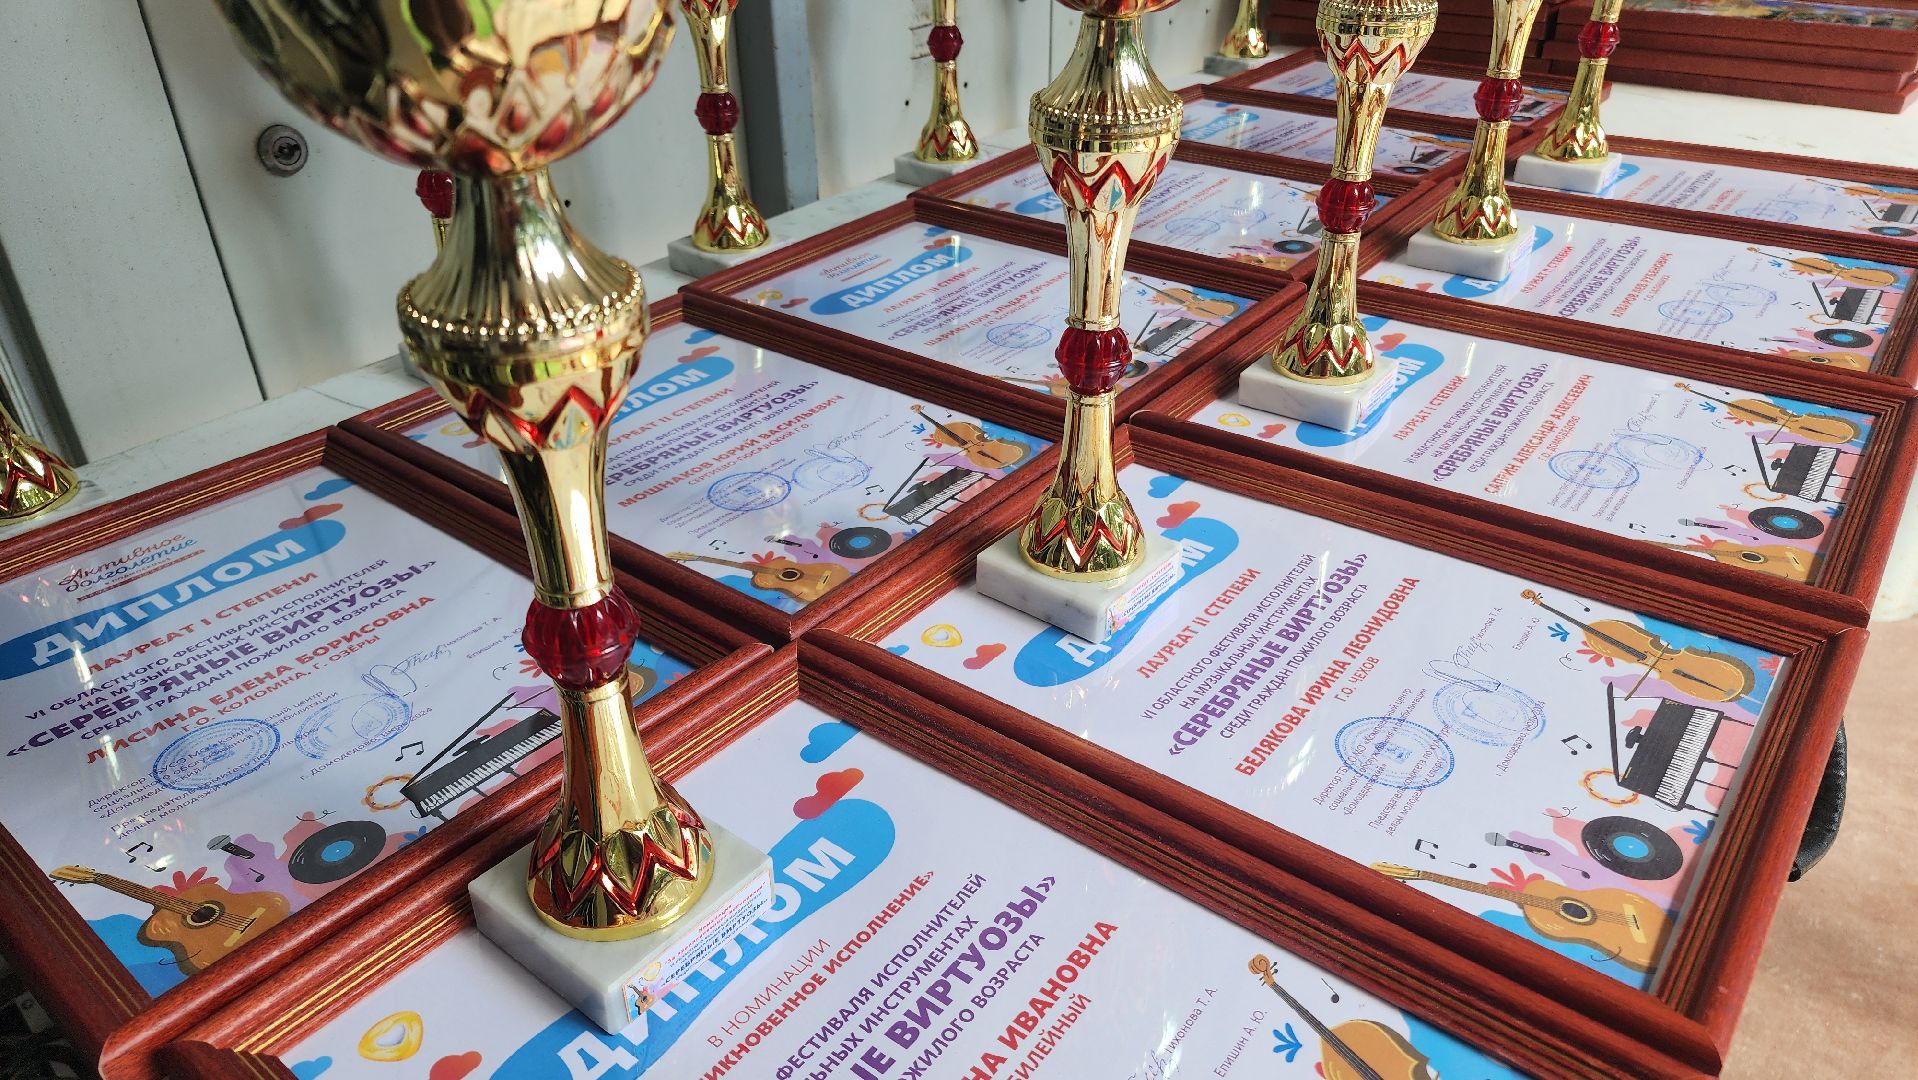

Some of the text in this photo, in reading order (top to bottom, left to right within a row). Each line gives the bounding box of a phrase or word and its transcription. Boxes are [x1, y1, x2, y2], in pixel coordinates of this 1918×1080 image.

[840, 253, 956, 308] ДИПЛОМ
[617, 462, 713, 507] МОШНАКОВ
[712, 438, 761, 462] ЮРИЙ
[757, 395, 844, 440] ВАСИЛЬЕВИЧ
[672, 388, 734, 417] СТЕПЕНИ
[714, 381, 818, 432] ВИРТУОЗЫ»
[1393, 376, 1467, 440] ЛАУРЕАТ СТЕПЕНИ
[1433, 363, 1548, 482] «СЕРЕБРЯНЫЕ ВИРТУОЗЫ»
[1512, 420, 1558, 464] АЛЕКСАНДР
[1550, 374, 1593, 420] АЛЕКСЕЕВИЧ
[32, 537, 307, 666] ДИПЛОМ
[57, 533, 187, 587] Активное
[66, 537, 199, 593] долголетие
[6, 561, 436, 757] «СЕРЕБРЯНЫЕ ВИРТУОЗЫ»
[25, 559, 389, 720] VI ОБЛАСТНОГО ФЕСТИВАЛЯ ИСПОЛНИТЕЛЕЙ
[78, 580, 367, 711] НА МУЗЫКАЛЬНЫХ ИНСТРУМЕНТАХ
[80, 589, 407, 740] СРЕДИ ГРАЖДАН ПОЖИЛОГО ВОЗРАСТА
[87, 623, 195, 675] ЛАУРЕАТ
[216, 573, 318, 619] СТЕПЕНИ
[1136, 625, 1199, 679] ЛАУРЕАТ
[1192, 617, 1210, 627] II
[1204, 568, 1261, 616] СТЕПЕНИ
[1142, 554, 1316, 720] VI ОБЛАСТНОГО ФЕСТИВАЛЯ ИСПОЛНИТЕЛЕЙ
[1169, 554, 1368, 755] «СЕРЕБРЯНЫЕ ВИРТУОЗЫ»
[1179, 576, 1318, 710] НА МУЗЫКАЛЬНЫХ ИНСТРУМЕНТАХ
[1220, 584, 1368, 738] СРЕДИ ГРАЖДАН ПОЖИЛОГО ВОЗРАСТА
[1235, 578, 1420, 776] БЕЛЯКОВА ИРИНА ЛЕОНИДОВНА
[1334, 656, 1379, 702] Г.О. ЧЕХОВ
[87, 597, 435, 765] ЛИСИНА ЕЛЕНА БОРИСОВНА
[180, 635, 380, 732] Г.О. КОЛОМНА, Г. ОЗЁРЫ
[776, 873, 987, 1080] ФЕСТИВАЛЯ ИСПОЛНИТЕЛЕЙ
[822, 871, 934, 974] ИСПОЛНЕНИЕ»
[858, 915, 979, 1034] ИНСТРУМЕНТАХ
[884, 876, 1055, 1050] ВИРТУОЗЫ»
[970, 934, 1045, 1009] ВОЗРАСТА
[707, 939, 831, 1048] В НОМИНАЦИИ
[997, 922, 1119, 1051] ИВАНОВНА
[1195, 997, 1210, 1012] Т.
[1205, 988, 1218, 999] А.
[1213, 1010, 1268, 1078] Епишин А. Ю.
